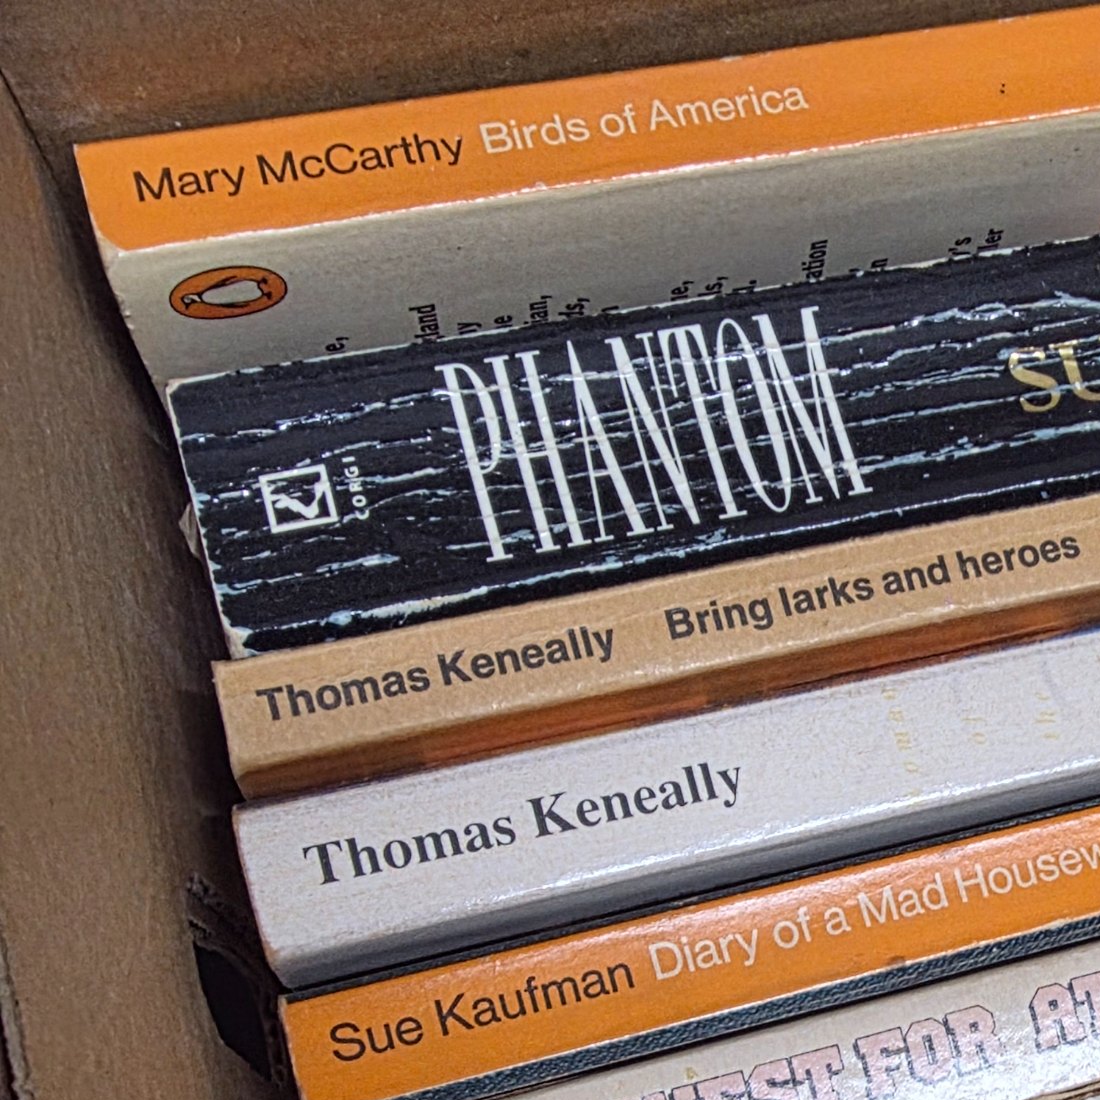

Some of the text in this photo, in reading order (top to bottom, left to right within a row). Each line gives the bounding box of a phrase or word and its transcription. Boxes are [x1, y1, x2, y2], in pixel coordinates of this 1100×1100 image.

[132, 133, 464, 202] Mary McCarthy
[479, 85, 810, 155] Birds of America
[435, 304, 873, 562] PHANTOM
[341, 456, 370, 520] CORGI
[664, 536, 1082, 641] Bring larks and heroes
[256, 625, 615, 722] Thomas Keneally
[302, 761, 743, 886] Thomas Keneally
[648, 915, 762, 982] Diary
[772, 906, 814, 951] of
[824, 905, 852, 937] a
[856, 871, 950, 930] Mad
[330, 961, 637, 1062] Sue Kaufman
